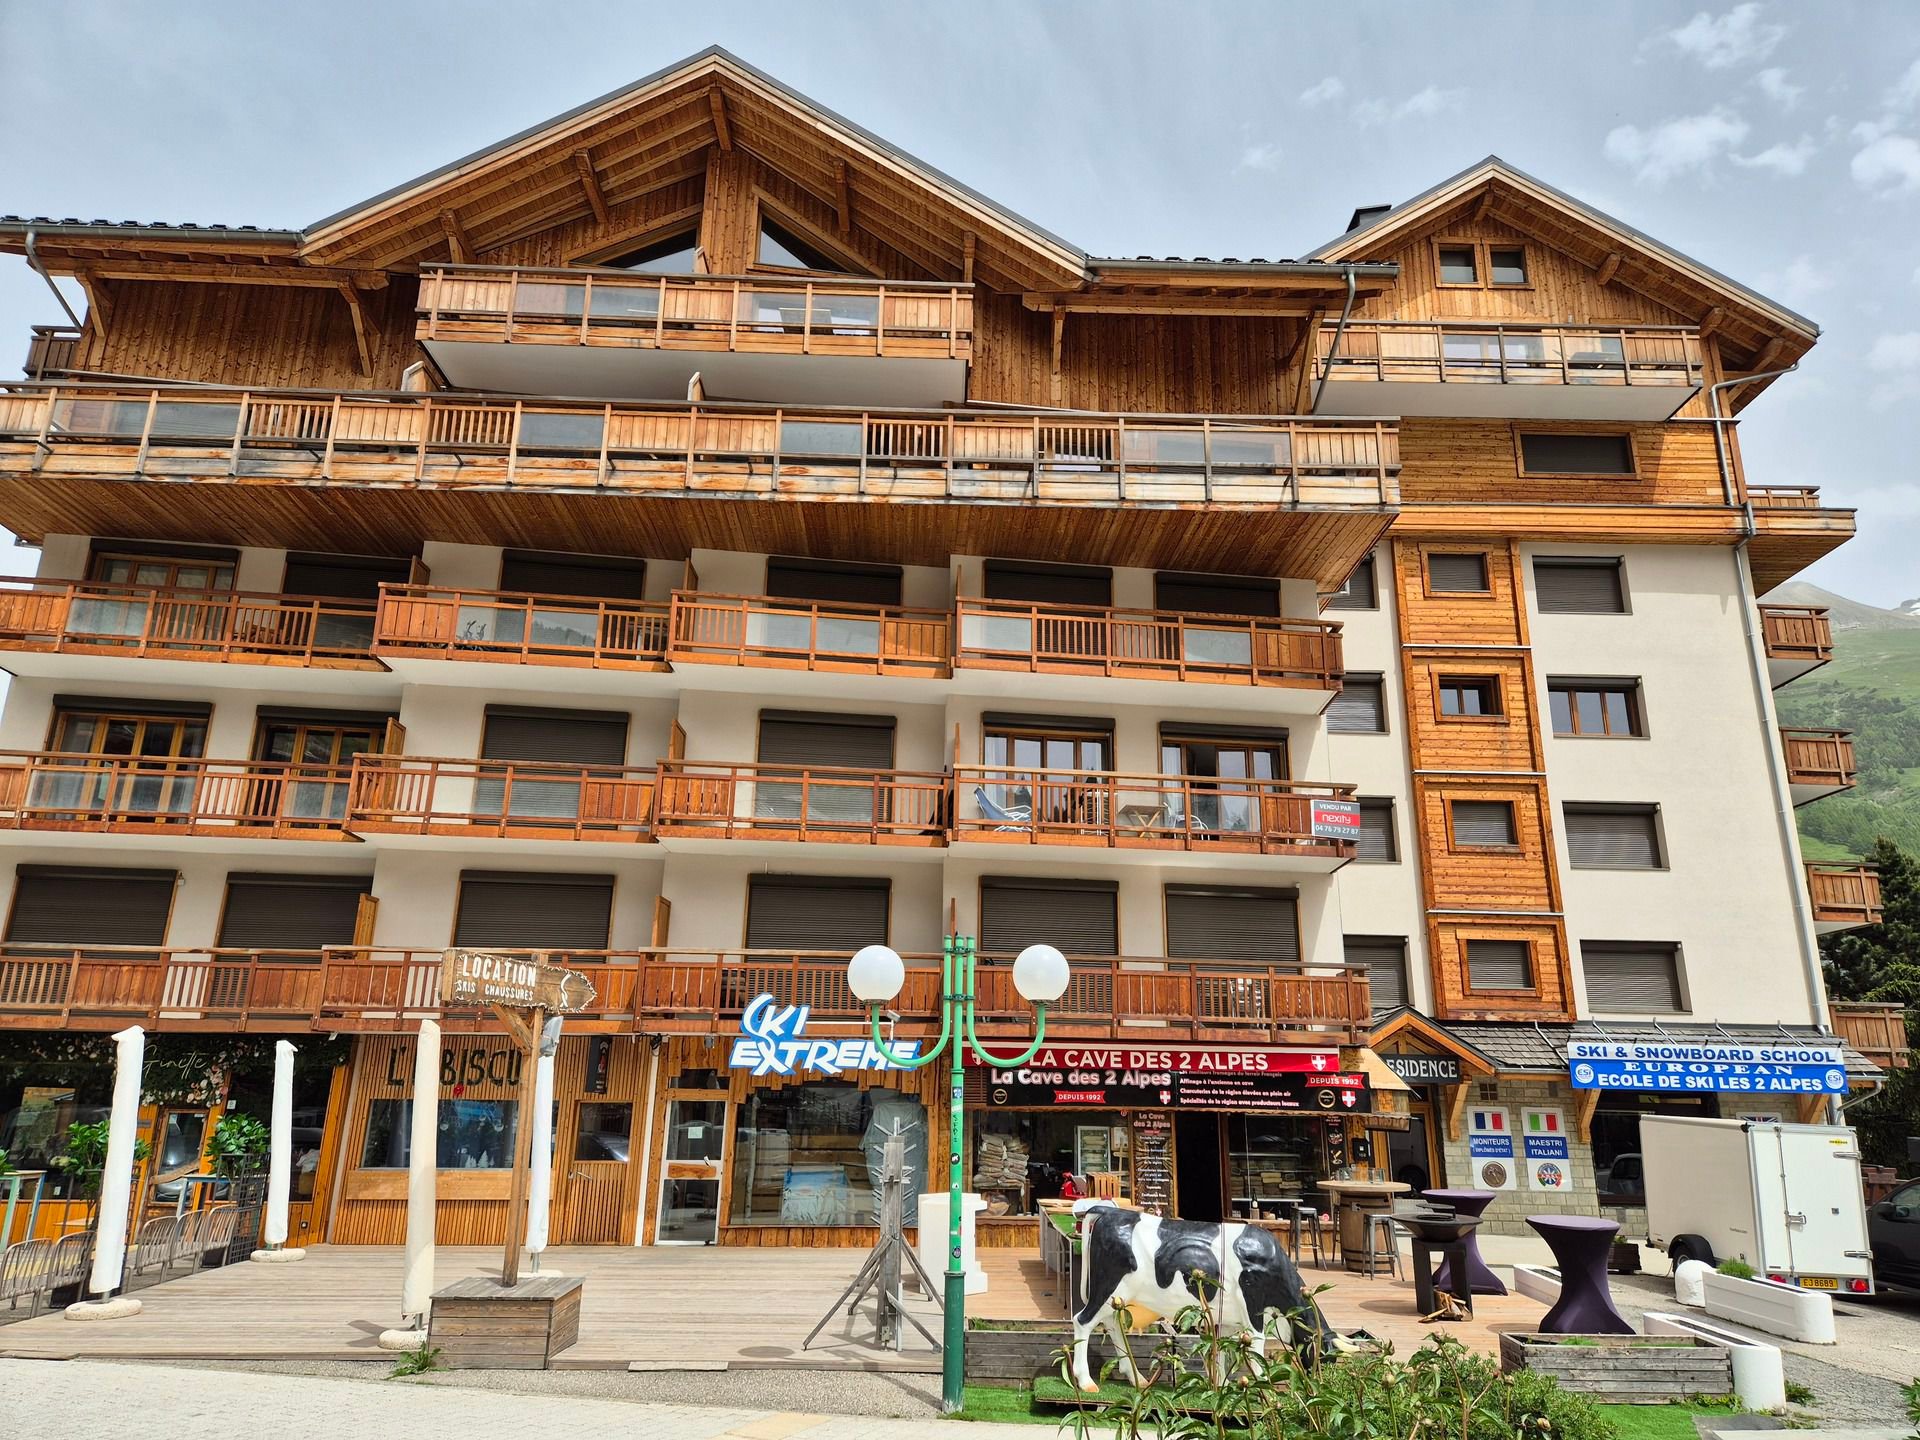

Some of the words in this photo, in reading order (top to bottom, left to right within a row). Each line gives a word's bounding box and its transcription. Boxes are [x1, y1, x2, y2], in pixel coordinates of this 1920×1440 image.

[1322, 814, 1351, 824] nexity
[462, 955, 537, 988] LOCATION
[457, 979, 476, 994] SKIS
[485, 983, 534, 1001] CHAUSSURES
[743, 994, 810, 1037] SKI
[730, 1040, 917, 1076] EXTREME
[1030, 1050, 1057, 1067] LA
[1064, 1050, 1123, 1068] CAVE
[1130, 1052, 1173, 1069] DES
[1179, 1052, 1192, 1069] 2
[1198, 1053, 1269, 1070] ALPES
[1576, 1045, 1608, 1057] SKI
[1615, 1047, 1628, 1058] &
[1635, 1047, 1754, 1061] SNOWBOARD
[1760, 1050, 1836, 1063] SCHOOL
[1386, 1059, 1457, 1078] ESIDENCE
[1623, 1062, 1793, 1076] EUROPEAN
[991, 1068, 1014, 1085] La
[1018, 1069, 1063, 1086] Cave
[1068, 1069, 1100, 1086] des
[1104, 1071, 1117, 1086] 2
[1121, 1070, 1172, 1090] Alpes
[1310, 1077, 1340, 1085] DEPUIS
[1597, 1074, 1654, 1087] ECOLE
[1658, 1075, 1682, 1088] DE
[1686, 1075, 1714, 1089] SKI
[1719, 1076, 1750, 1090] LES
[1754, 1077, 1766, 1090] 2
[1769, 1078, 1823, 1091] ALPES
[1058, 1093, 1085, 1101] DEPUIS
[1472, 1138, 1510, 1146] MONITEURS
[1529, 1139, 1562, 1147] MAESTRI
[1531, 1148, 1562, 1156] ITALIANI
